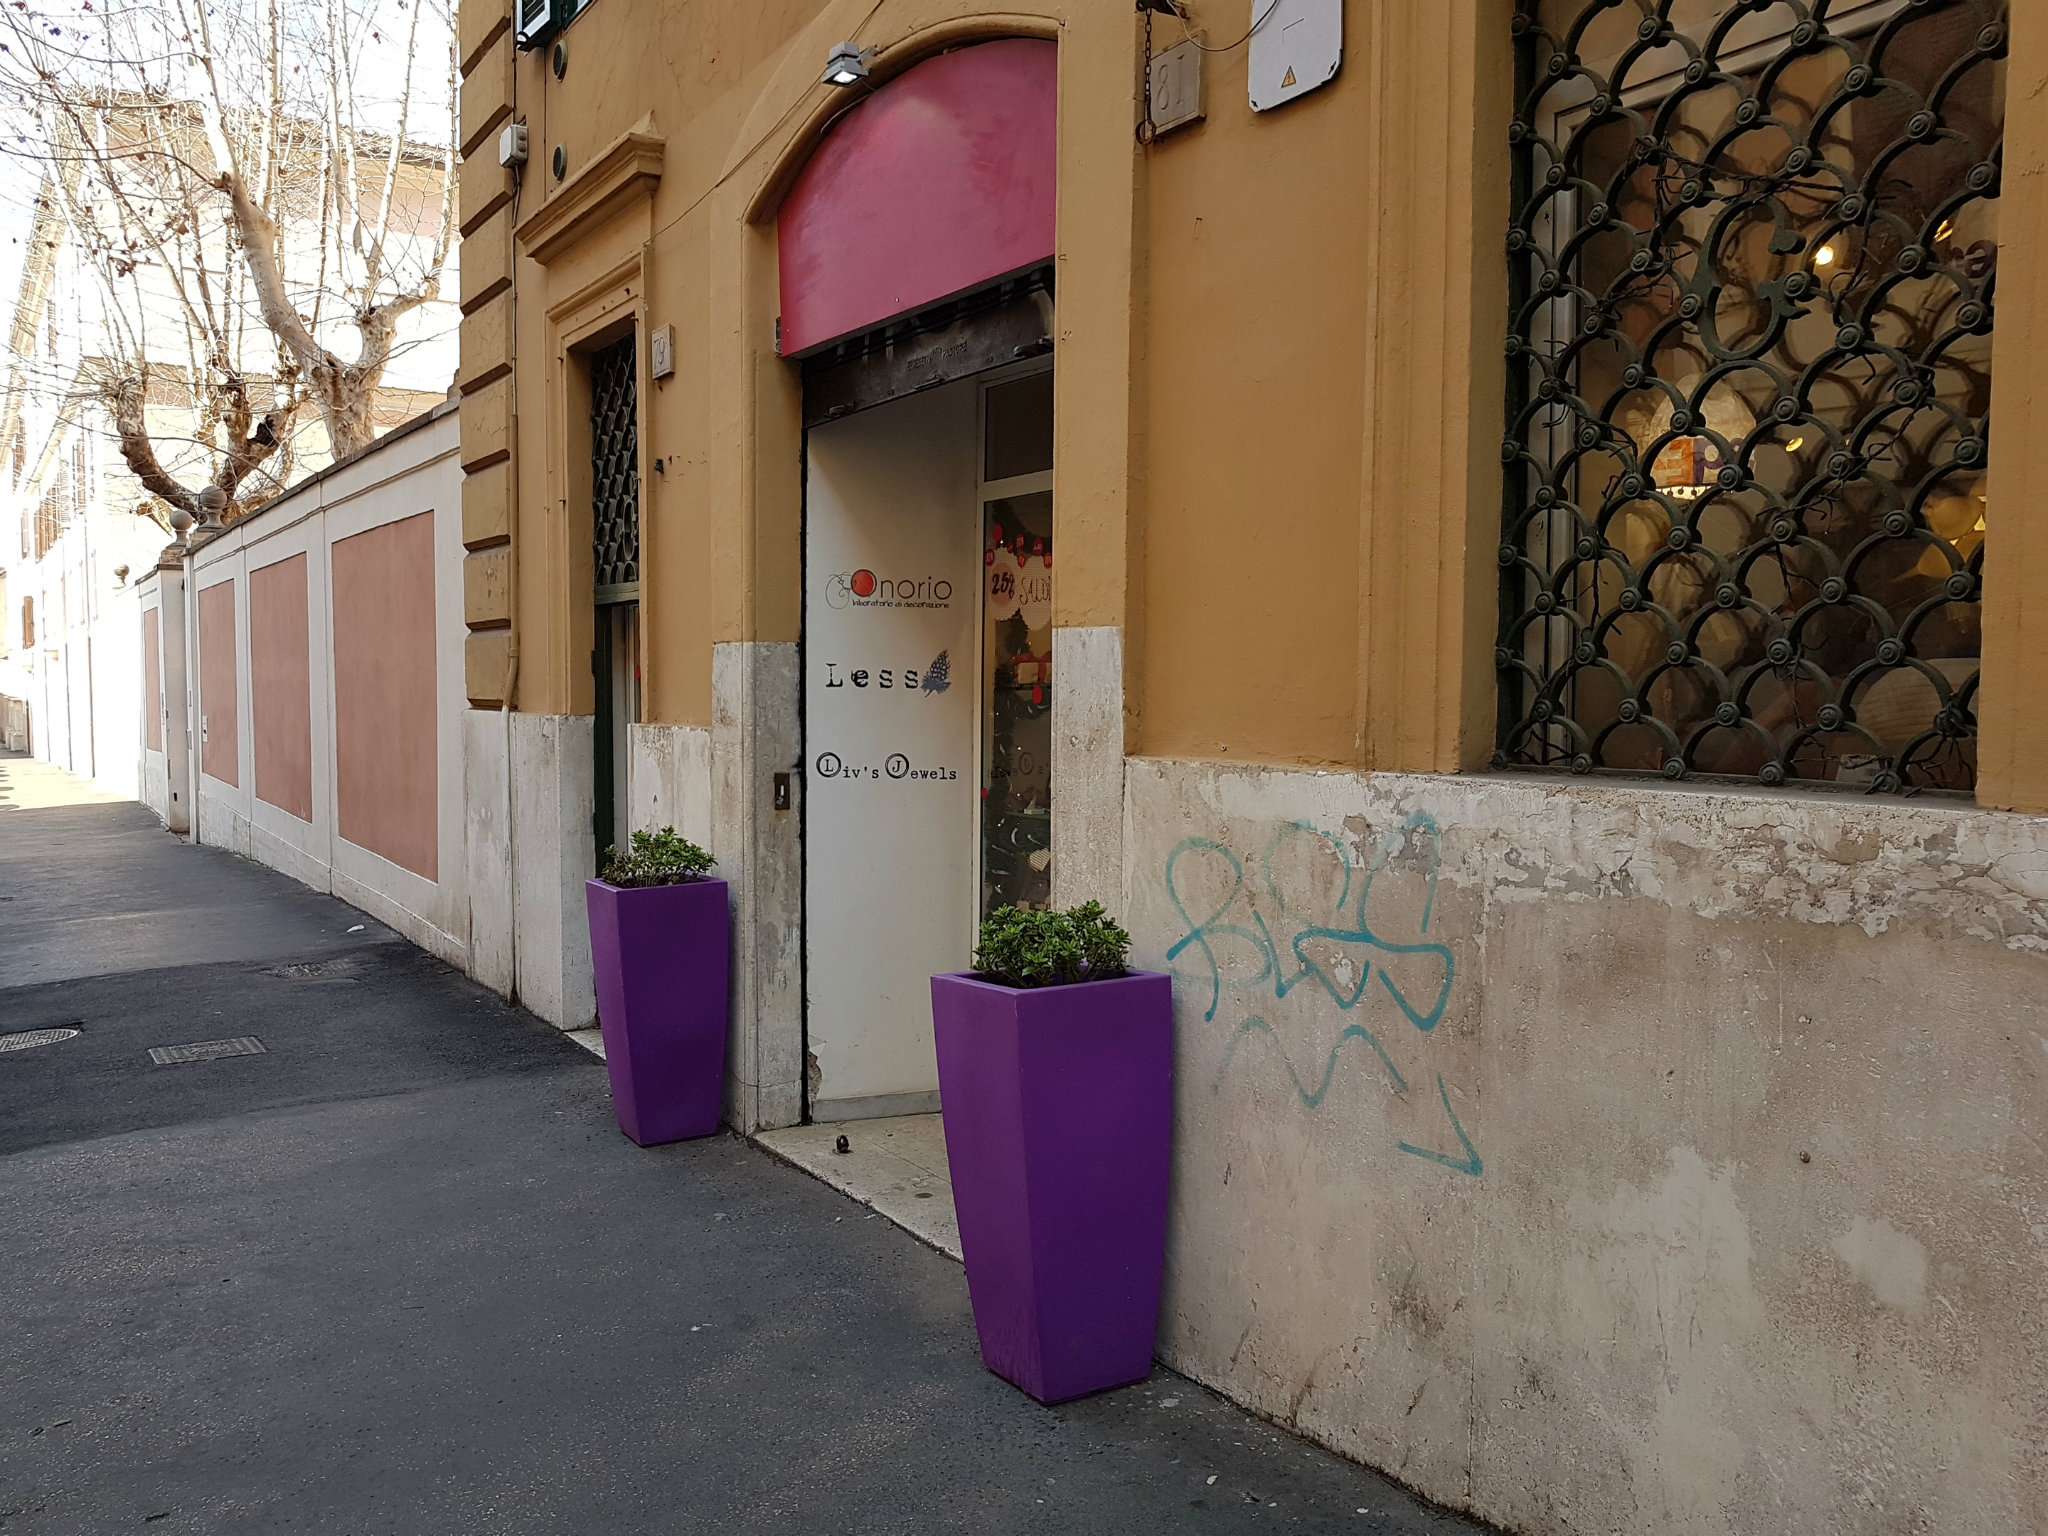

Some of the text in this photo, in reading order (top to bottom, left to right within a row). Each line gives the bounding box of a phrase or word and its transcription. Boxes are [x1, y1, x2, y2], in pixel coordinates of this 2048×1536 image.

[1156, 54, 1185, 111] 81
[851, 569, 953, 600] Onorio
[825, 663, 919, 689] Less
[816, 752, 957, 780] Liv's Jewels
